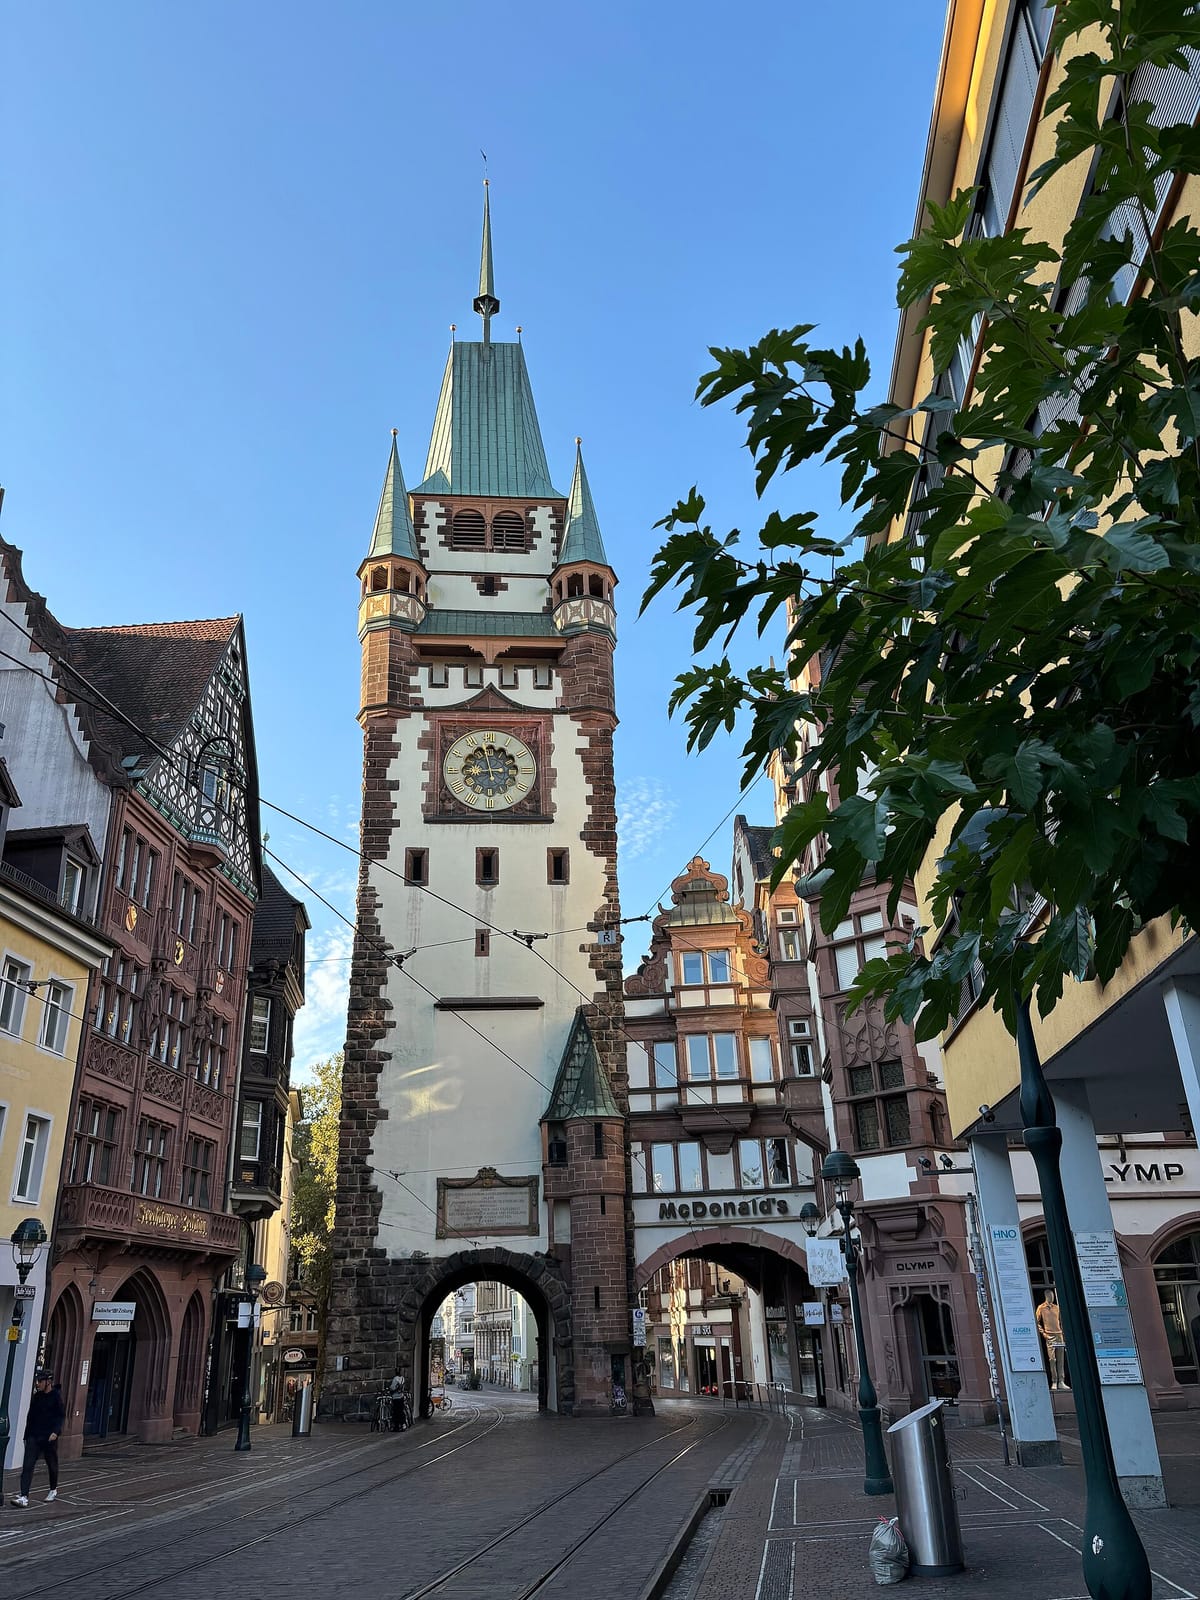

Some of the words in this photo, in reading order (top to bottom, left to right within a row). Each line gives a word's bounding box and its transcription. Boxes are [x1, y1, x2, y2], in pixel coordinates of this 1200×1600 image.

[658, 1197, 789, 1220] McDonald's
[993, 1229, 1017, 1239] HNO
[896, 1261, 935, 1271] OLYMP
